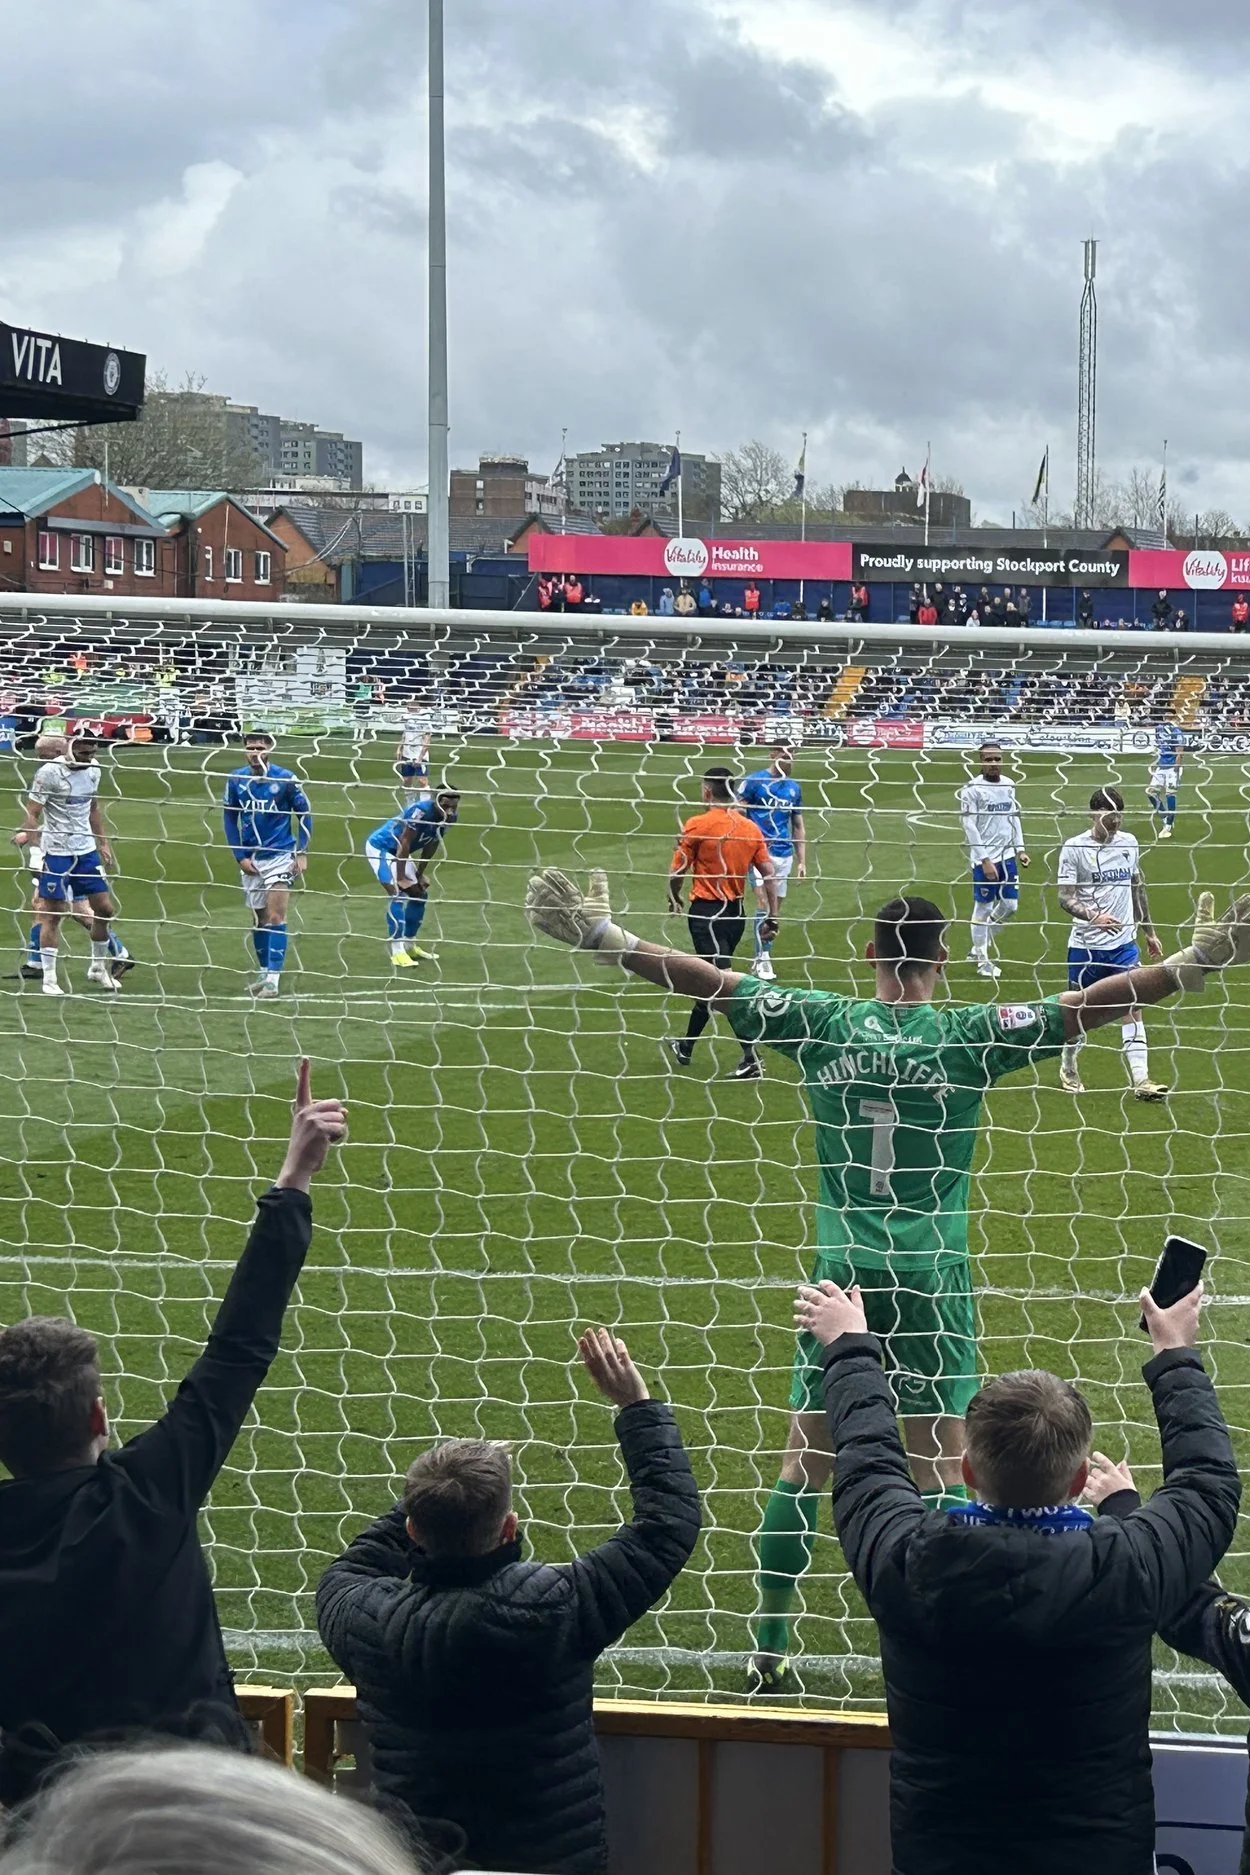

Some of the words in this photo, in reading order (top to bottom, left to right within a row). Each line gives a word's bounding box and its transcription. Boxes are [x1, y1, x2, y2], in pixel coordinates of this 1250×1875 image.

[11, 332, 63, 386] VITA
[665, 546, 706, 568] Vitality
[711, 546, 759, 561] Health
[711, 560, 763, 572] insurance
[860, 554, 914, 572] Proudly
[916, 555, 993, 574] supporting
[996, 557, 1067, 575] Stockport
[1068, 559, 1120, 577] County
[1185, 558, 1226, 581] Vitality
[816, 1052, 956, 1102] HINCHLIFFE
